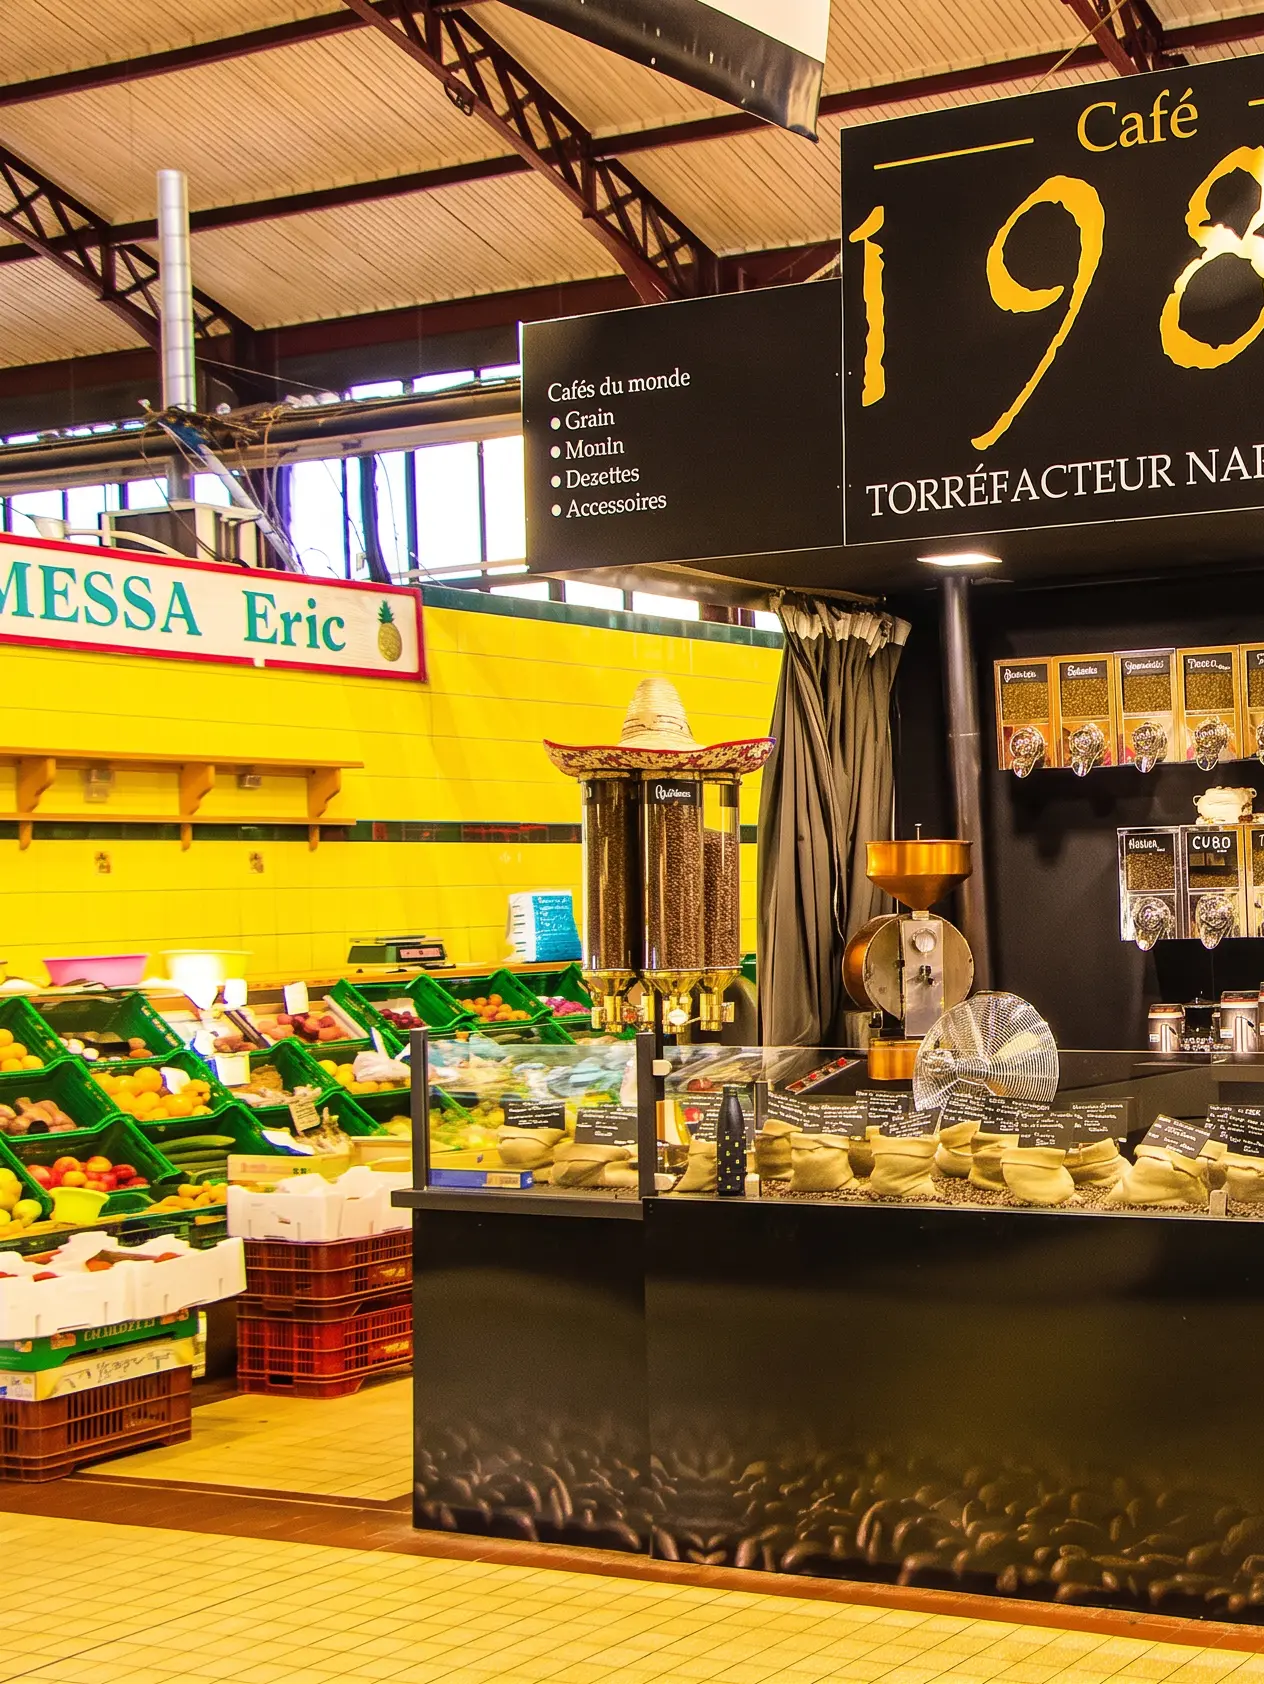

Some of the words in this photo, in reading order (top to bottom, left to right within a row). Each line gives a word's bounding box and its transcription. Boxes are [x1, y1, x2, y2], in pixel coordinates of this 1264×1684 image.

[1077, 87, 1199, 153] Café
[547, 379, 596, 402] Cafés
[599, 376, 624, 397] du
[627, 367, 691, 393] monde
[565, 408, 616, 430] Grain
[565, 492, 667, 519] Accessoires
[865, 453, 1176, 518] TORRÉFACTEUR
[242, 589, 347, 652] Eric
